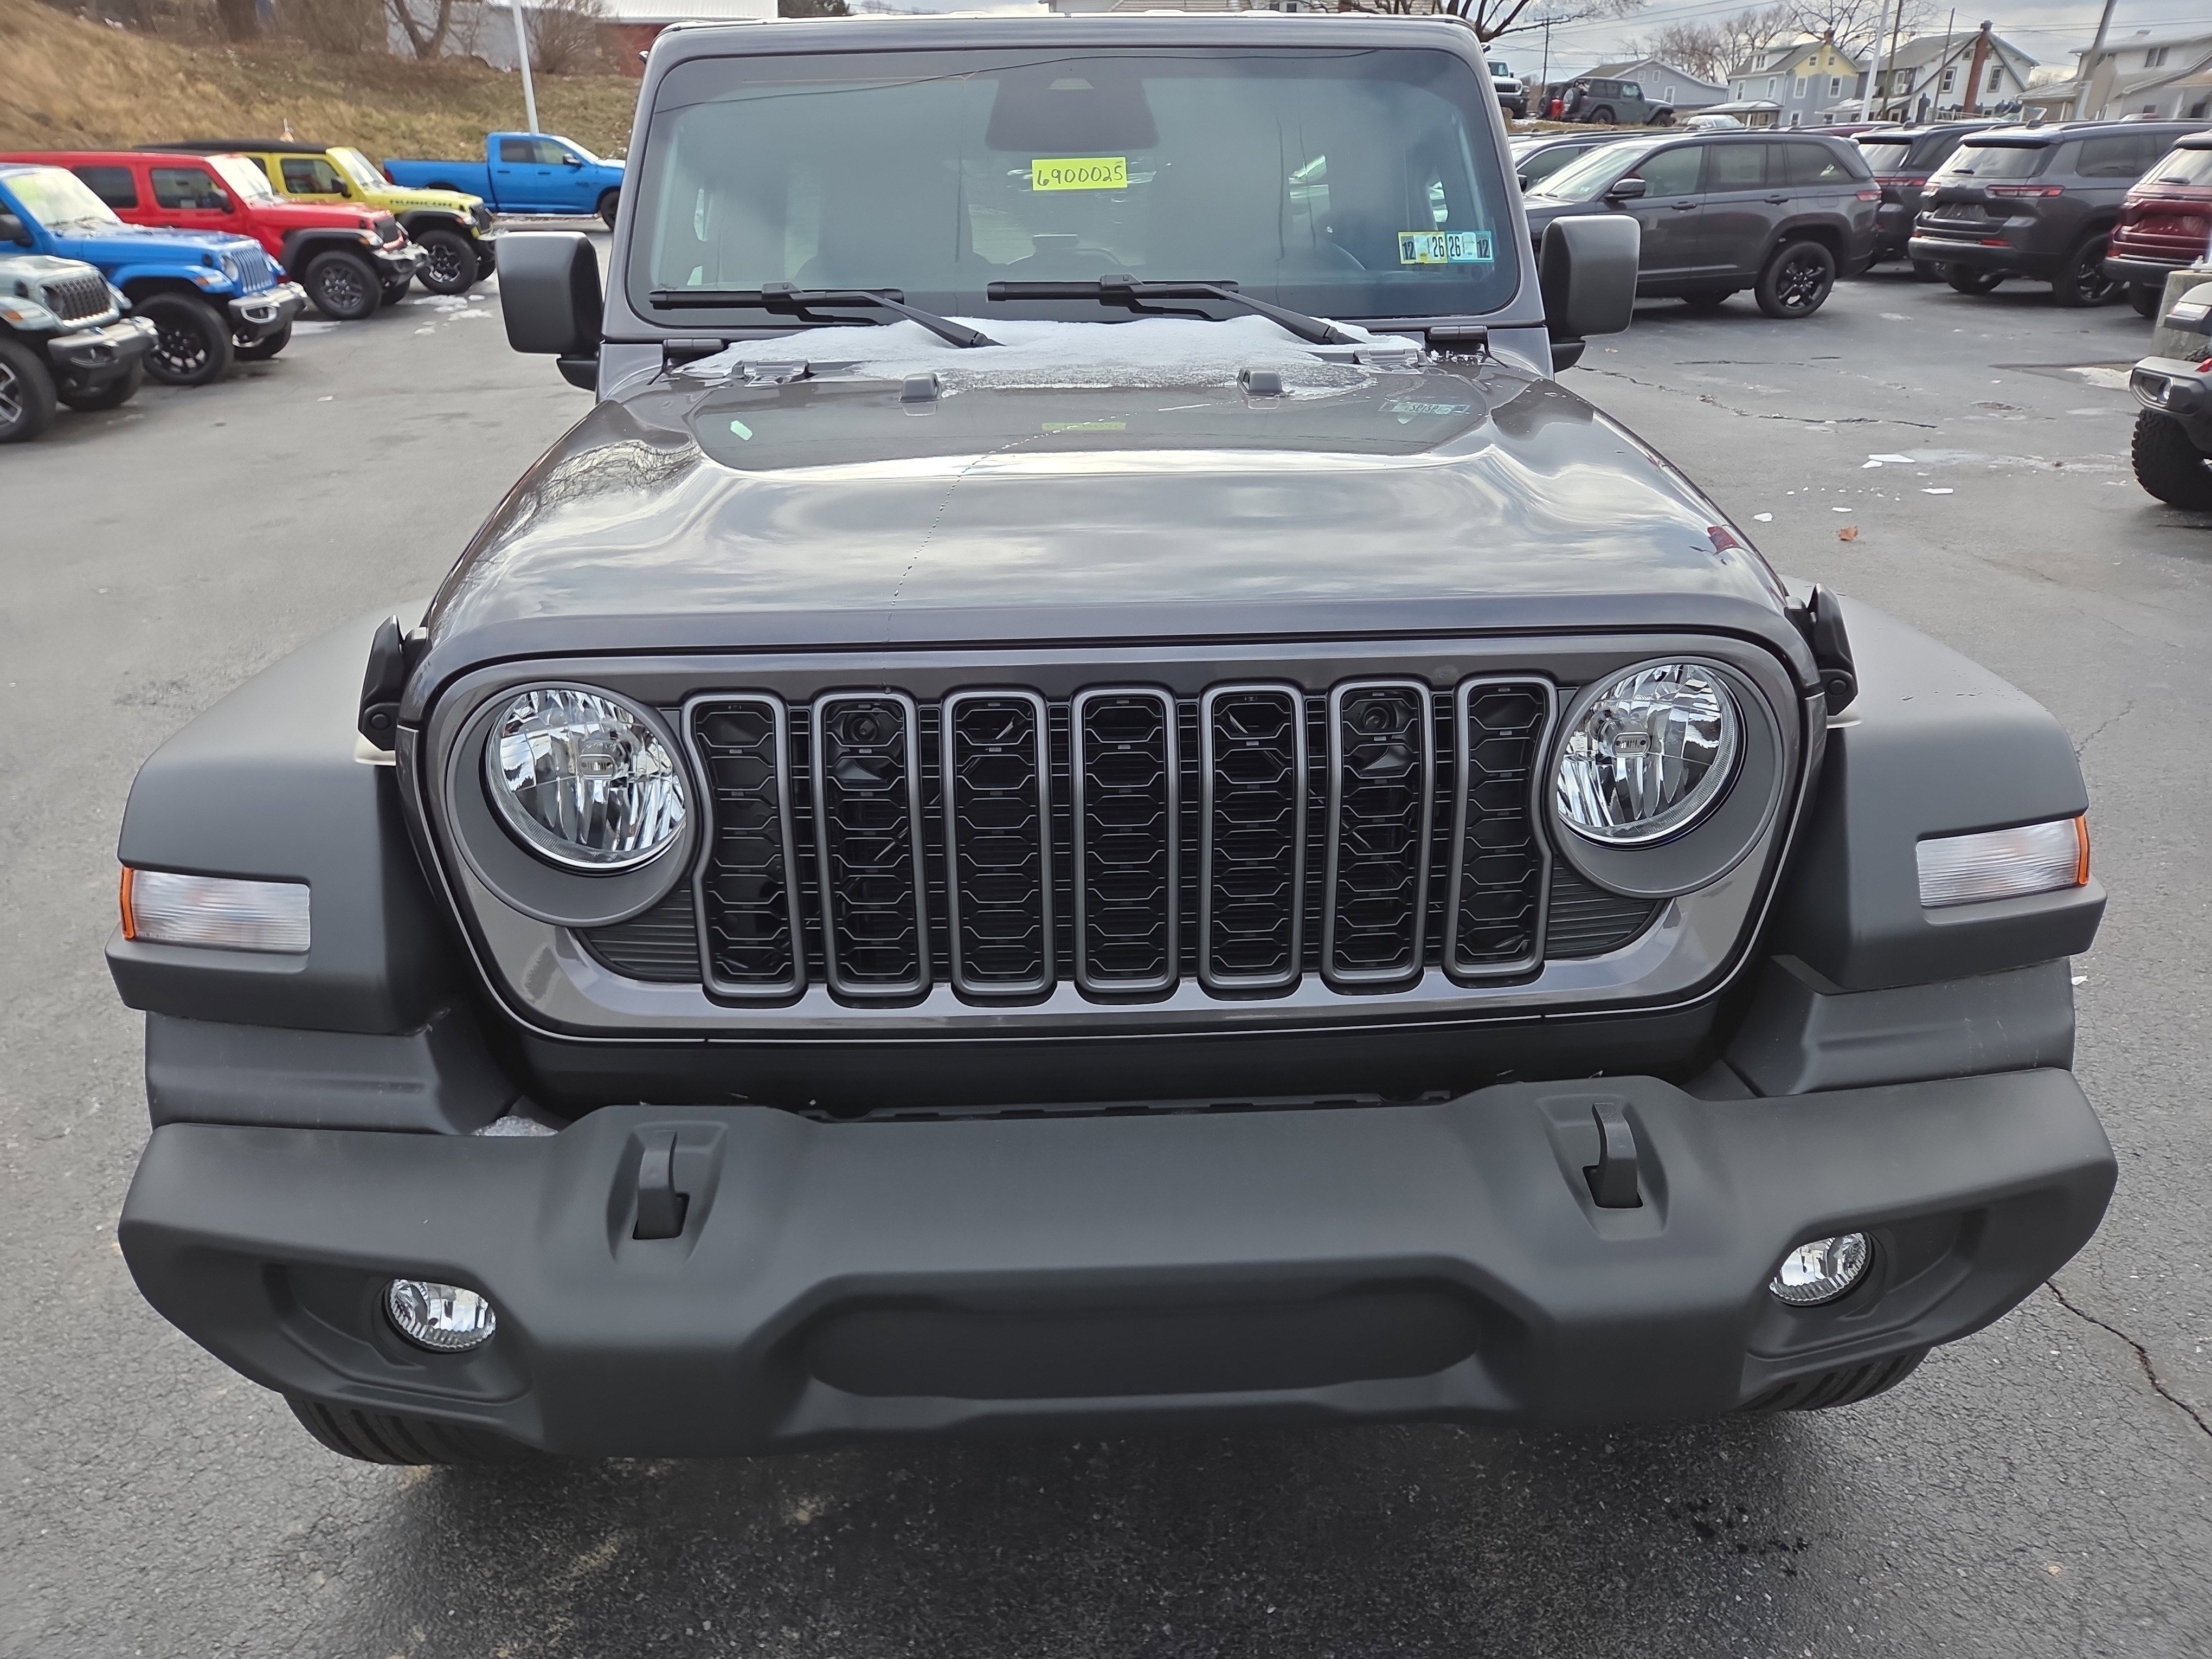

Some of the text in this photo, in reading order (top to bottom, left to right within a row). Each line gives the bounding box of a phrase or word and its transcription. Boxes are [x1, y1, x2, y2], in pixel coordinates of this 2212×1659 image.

[1037, 164, 1123, 187] 6900025
[1401, 241, 1417, 260] 12
[1432, 236, 1445, 258] 26
[1448, 235, 1461, 257] 26
[1476, 239, 1490, 258] 12
